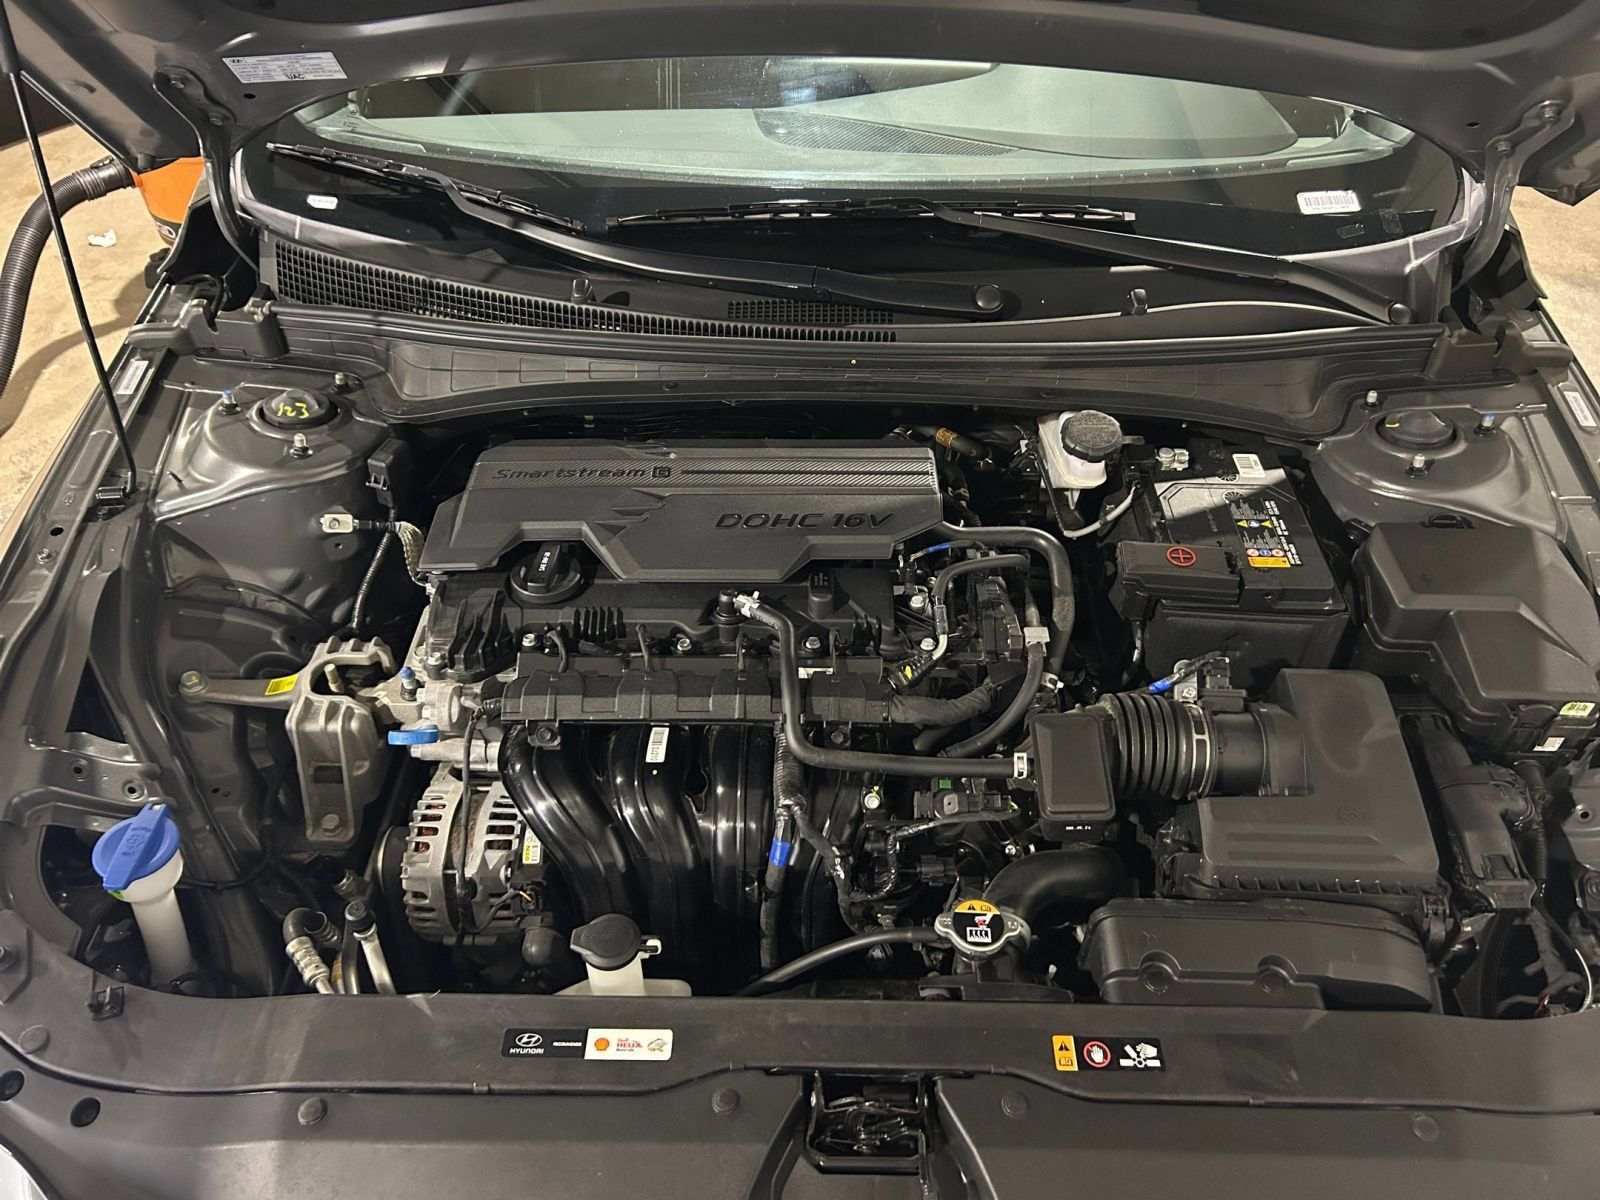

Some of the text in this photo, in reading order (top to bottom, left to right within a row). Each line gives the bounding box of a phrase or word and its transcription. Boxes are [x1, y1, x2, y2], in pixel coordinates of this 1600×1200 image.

[491, 467, 646, 480] Smartstream
[715, 513, 895, 528] DOHC 16V
